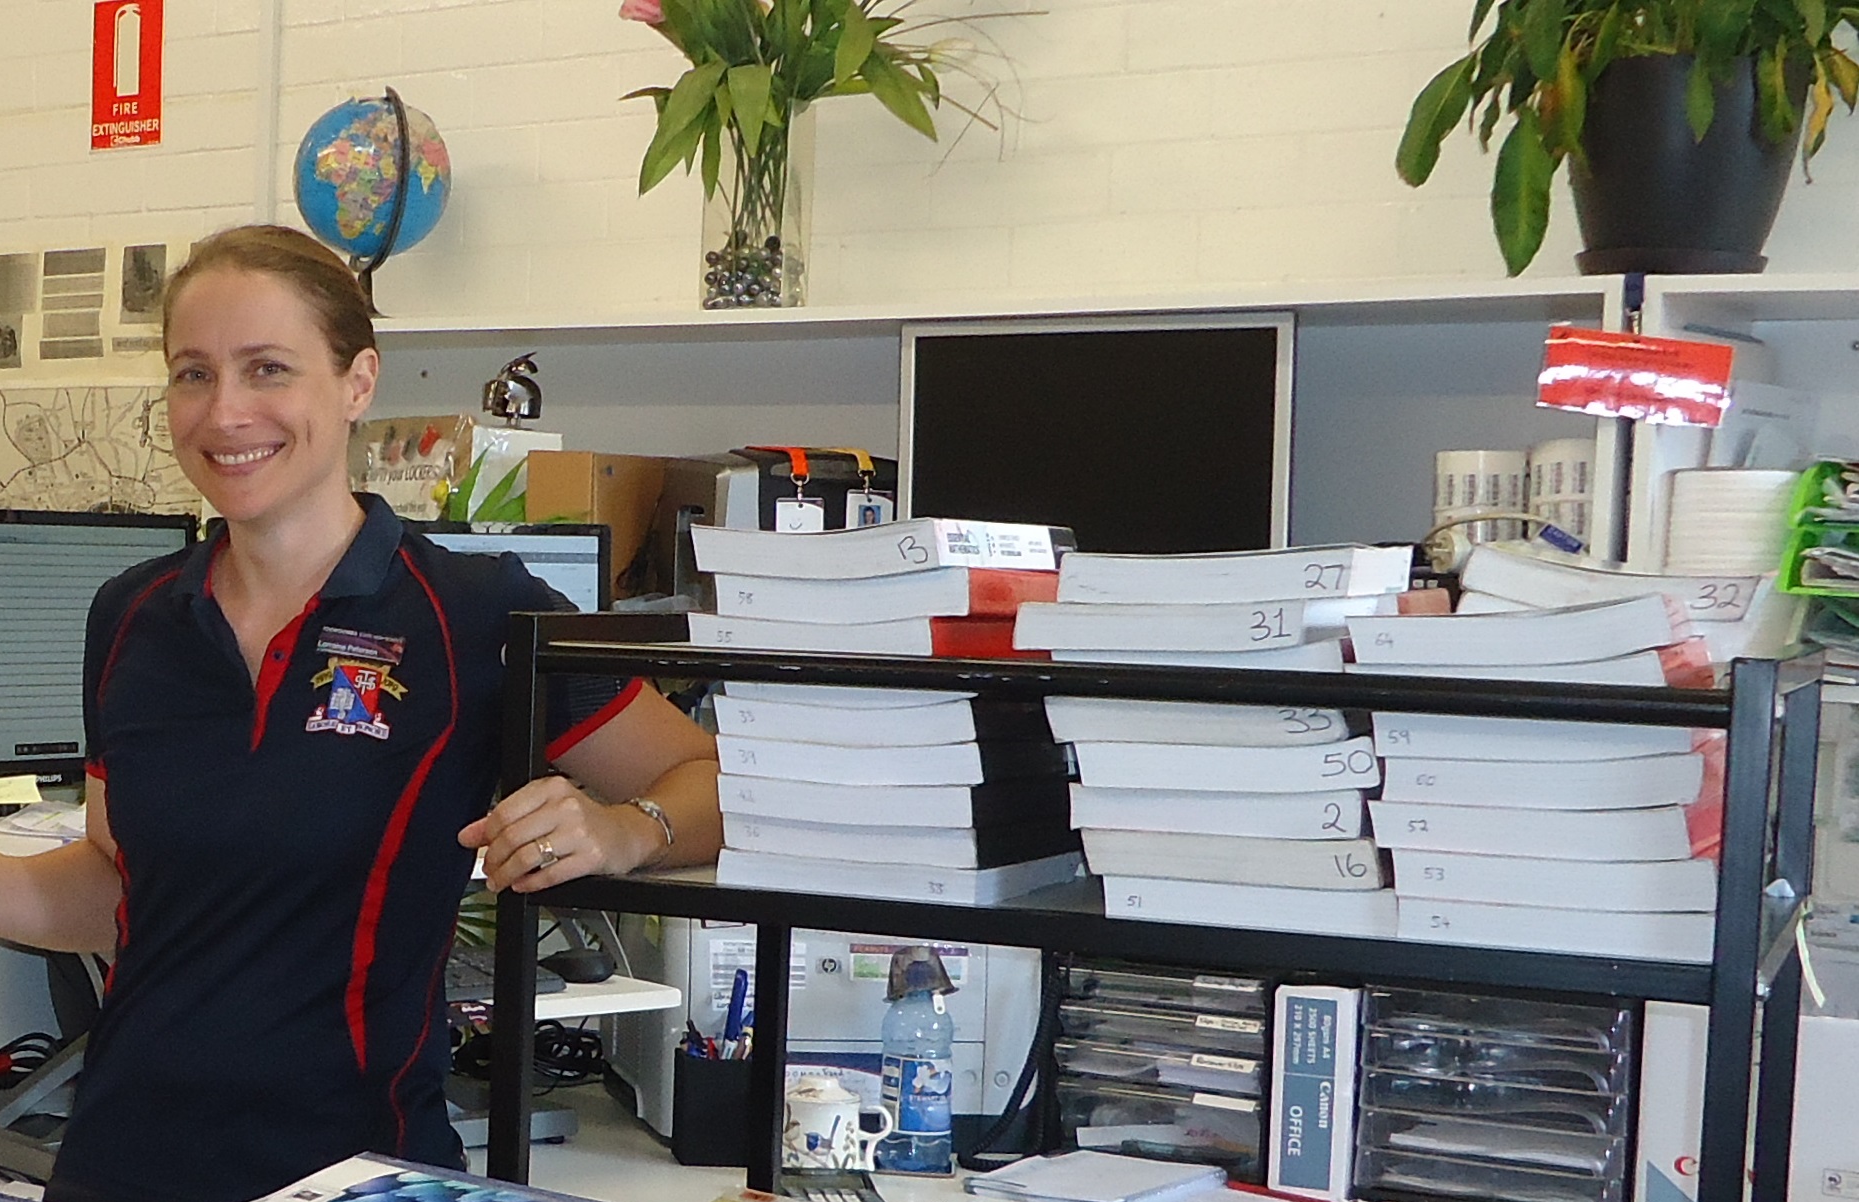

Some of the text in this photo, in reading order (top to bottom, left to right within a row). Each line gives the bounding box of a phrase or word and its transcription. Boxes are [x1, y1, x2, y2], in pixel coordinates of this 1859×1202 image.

[112, 101, 138, 117] FIRE
[92, 118, 160, 137] EXTINGUISHER
[1304, 562, 1346, 589] 27
[1690, 583, 1741, 610] 32
[1250, 607, 1292, 641] 31
[1278, 708, 1333, 734] 33
[1321, 749, 1374, 778] 50
[35, 774, 62, 784] PHILIPS
[1321, 802, 1347, 833] 2
[1334, 853, 1368, 878] 16
[1293, 1003, 1303, 1022] 210
[1306, 1006, 1318, 1065] 2500 SHEETS
[1321, 1046, 1332, 1060] A4
[1318, 1080, 1332, 1129] Canon
[1287, 1104, 1304, 1157] OFFICE
